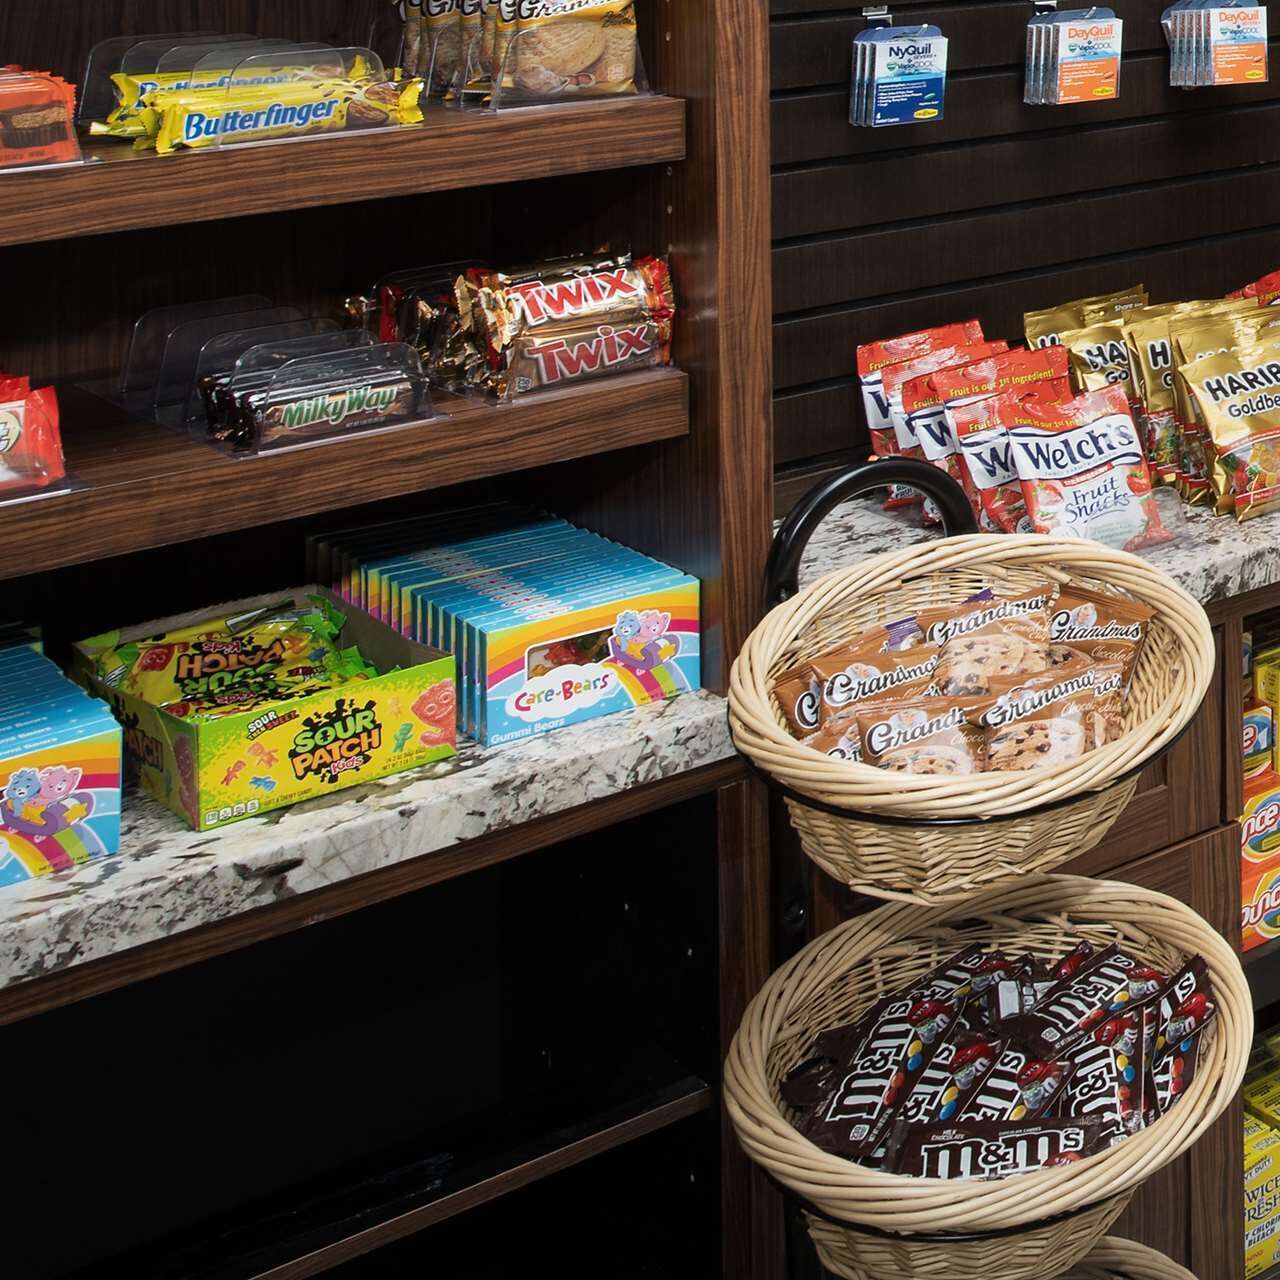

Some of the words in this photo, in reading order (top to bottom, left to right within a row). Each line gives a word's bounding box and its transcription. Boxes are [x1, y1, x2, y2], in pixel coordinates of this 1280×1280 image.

[1068, 24, 1113, 40] DayQuil
[1219, 11, 1260, 25] DayQuil
[889, 43, 932, 59] NyQuil
[185, 99, 339, 141] Butterfinger
[950, 386, 971, 398] Fruit
[971, 385, 980, 394] is
[1011, 368, 1055, 386] Ingredient!
[281, 393, 348, 430] Milky
[343, 385, 398, 414] Way
[1018, 422, 1136, 471] Welch's
[1072, 476, 1119, 507] Fruit
[1064, 492, 1132, 524] Snacks
[1050, 612, 1143, 642] Grandma's
[247, 710, 278, 732] SOUR
[294, 710, 376, 755] SOUR
[490, 725, 532, 744] Gummi
[533, 717, 566, 734] Bears
[291, 728, 382, 779] PATCH
[330, 755, 366, 777] Kids
[1248, 1226, 1276, 1247] BLEACH
